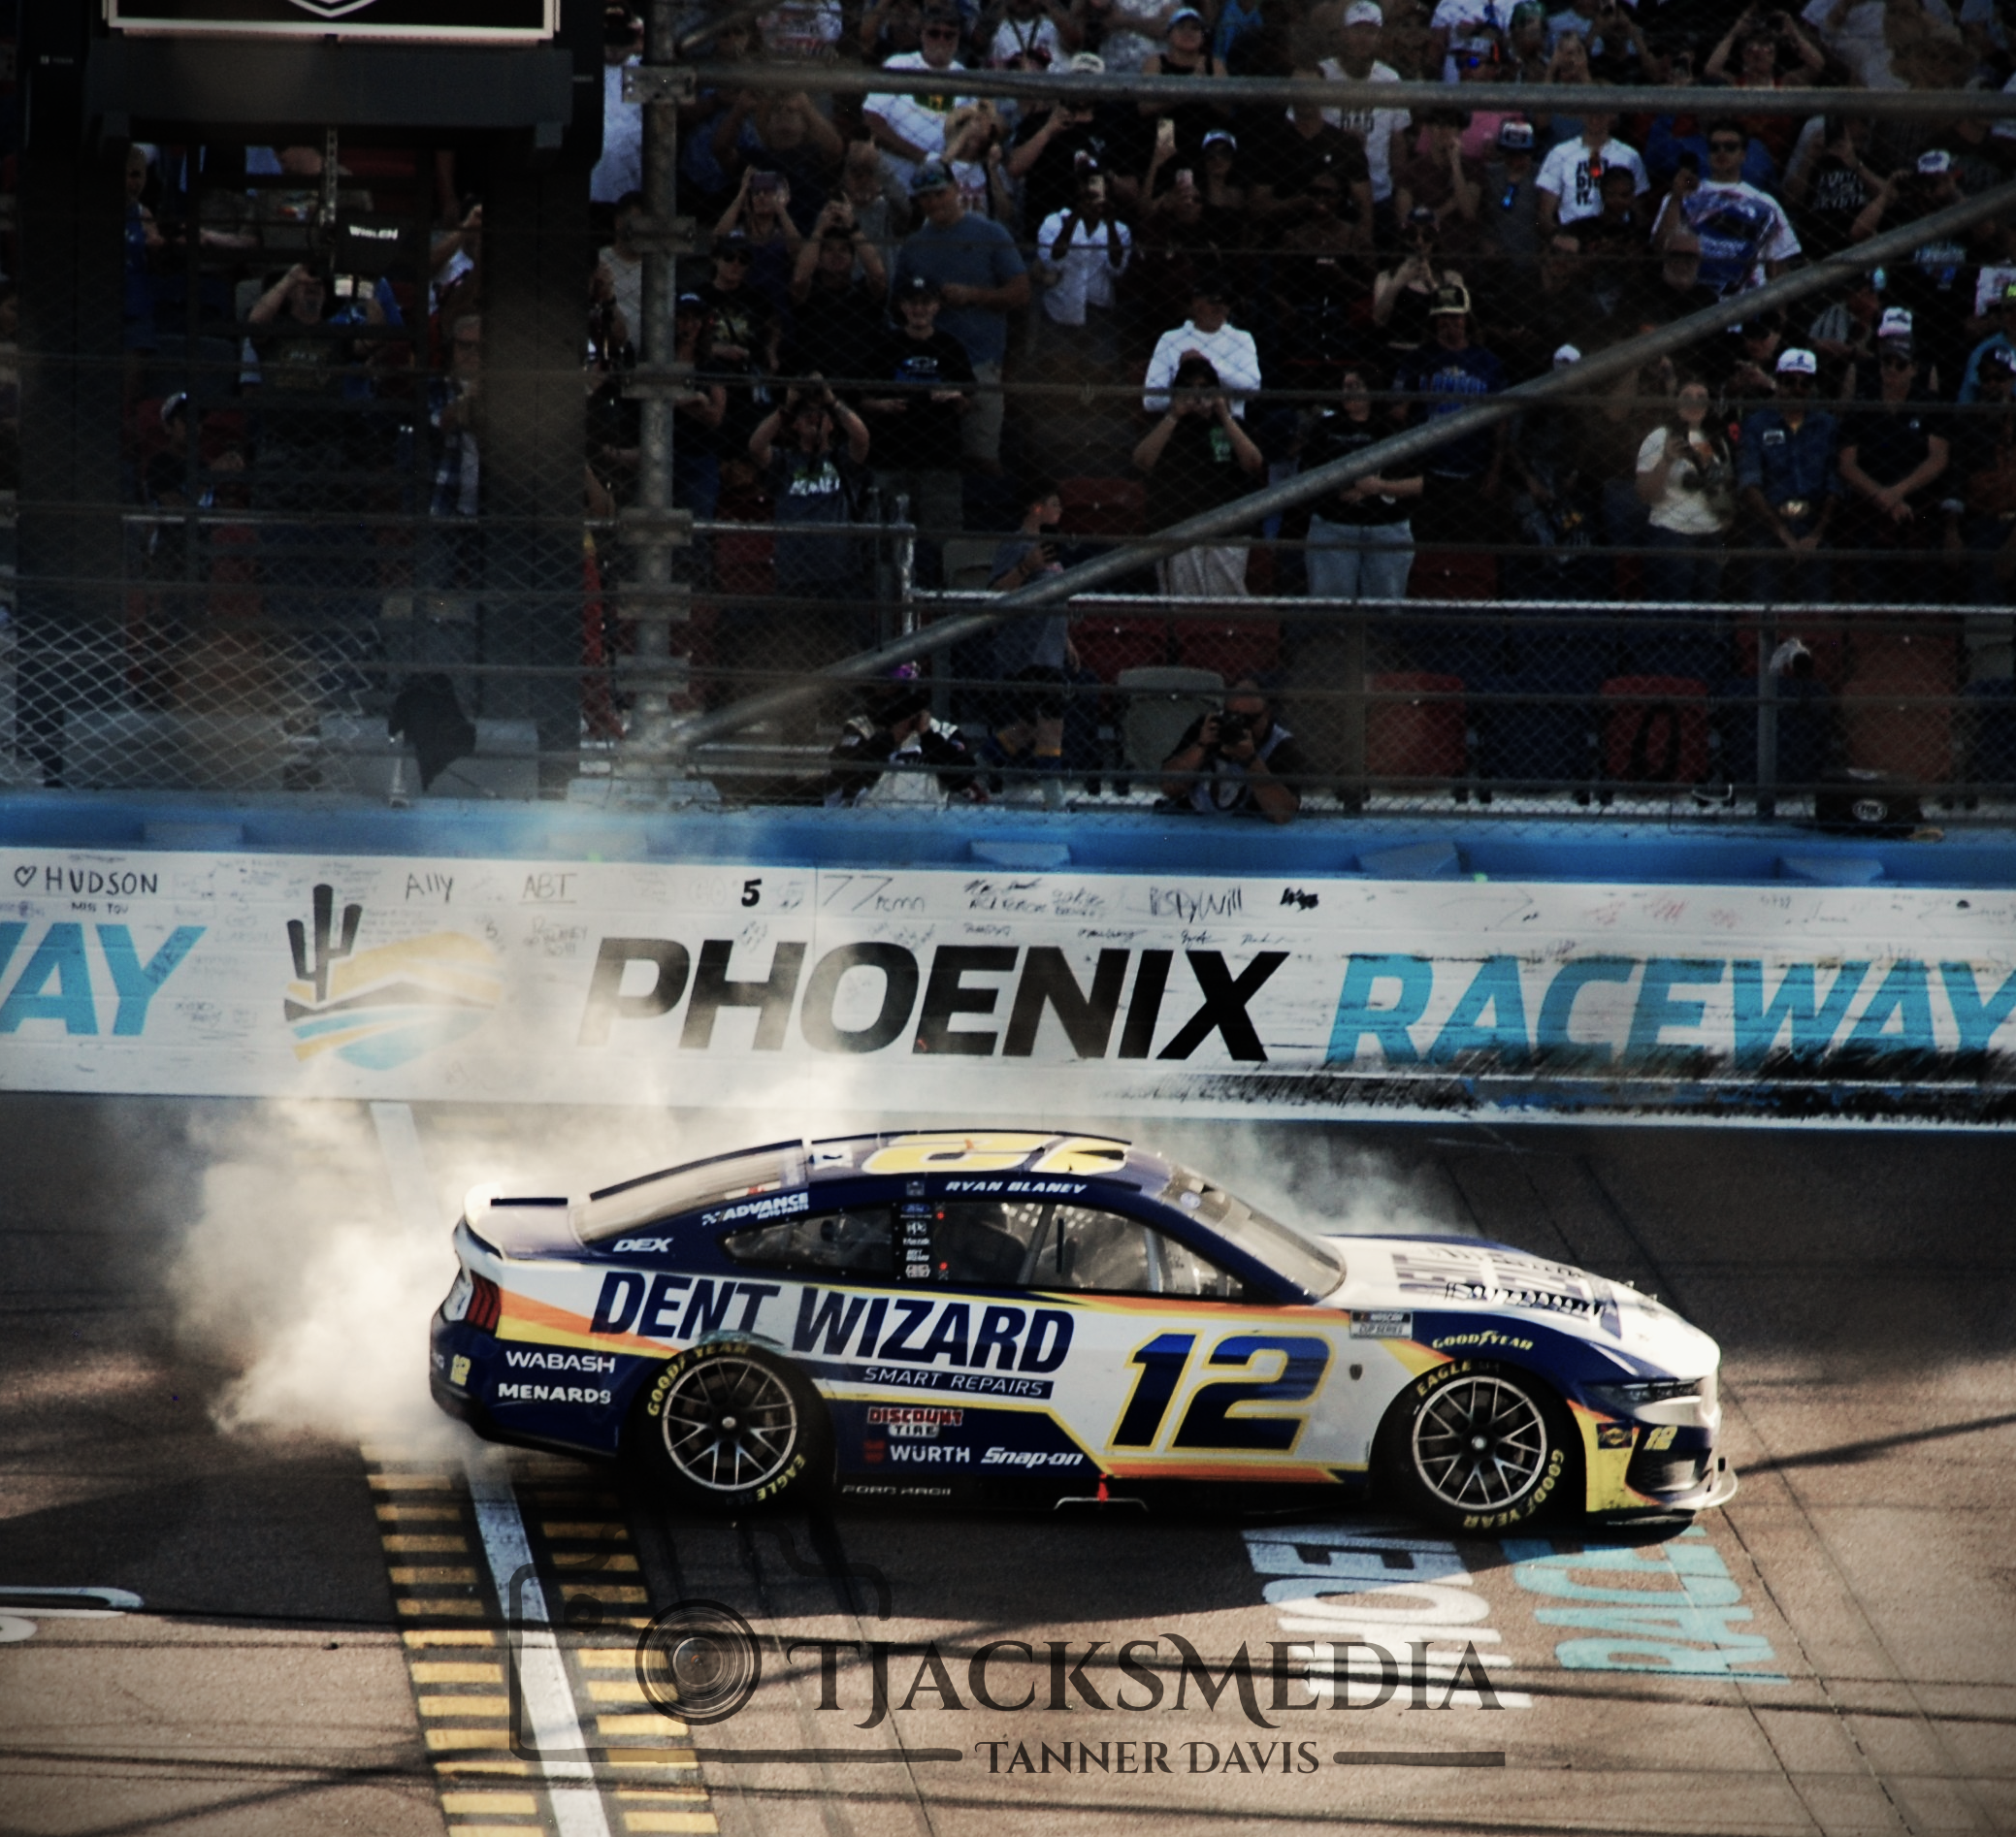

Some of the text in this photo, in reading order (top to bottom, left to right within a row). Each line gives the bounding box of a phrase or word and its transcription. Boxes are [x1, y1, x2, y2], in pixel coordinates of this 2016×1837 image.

[46, 866, 158, 895] HUDSON
[740, 878, 763, 908] 5
[577, 937, 2016, 1066] PHOENIX RACEWAY
[944, 1180, 1089, 1195] RYAN BLANEY
[722, 1192, 809, 1222] ADVANCE
[612, 1237, 674, 1254] DEX
[589, 1271, 1076, 1374] DENT WIZARD
[1431, 1330, 1534, 1351] GOODYEAR
[505, 1350, 616, 1373] WABASH
[862, 1366, 1046, 1398] SMART REPAIRS
[1103, 1327, 1336, 1456] 12
[1415, 1359, 1473, 1398] EAGLE
[498, 1382, 611, 1404] MENARDS
[867, 1406, 963, 1427] DISCOUNT
[892, 1424, 937, 1436] TIRE
[1642, 1426, 1678, 1451] 12
[980, 1446, 1085, 1468] Snap-on
[756, 1454, 807, 1502] EAGLE
